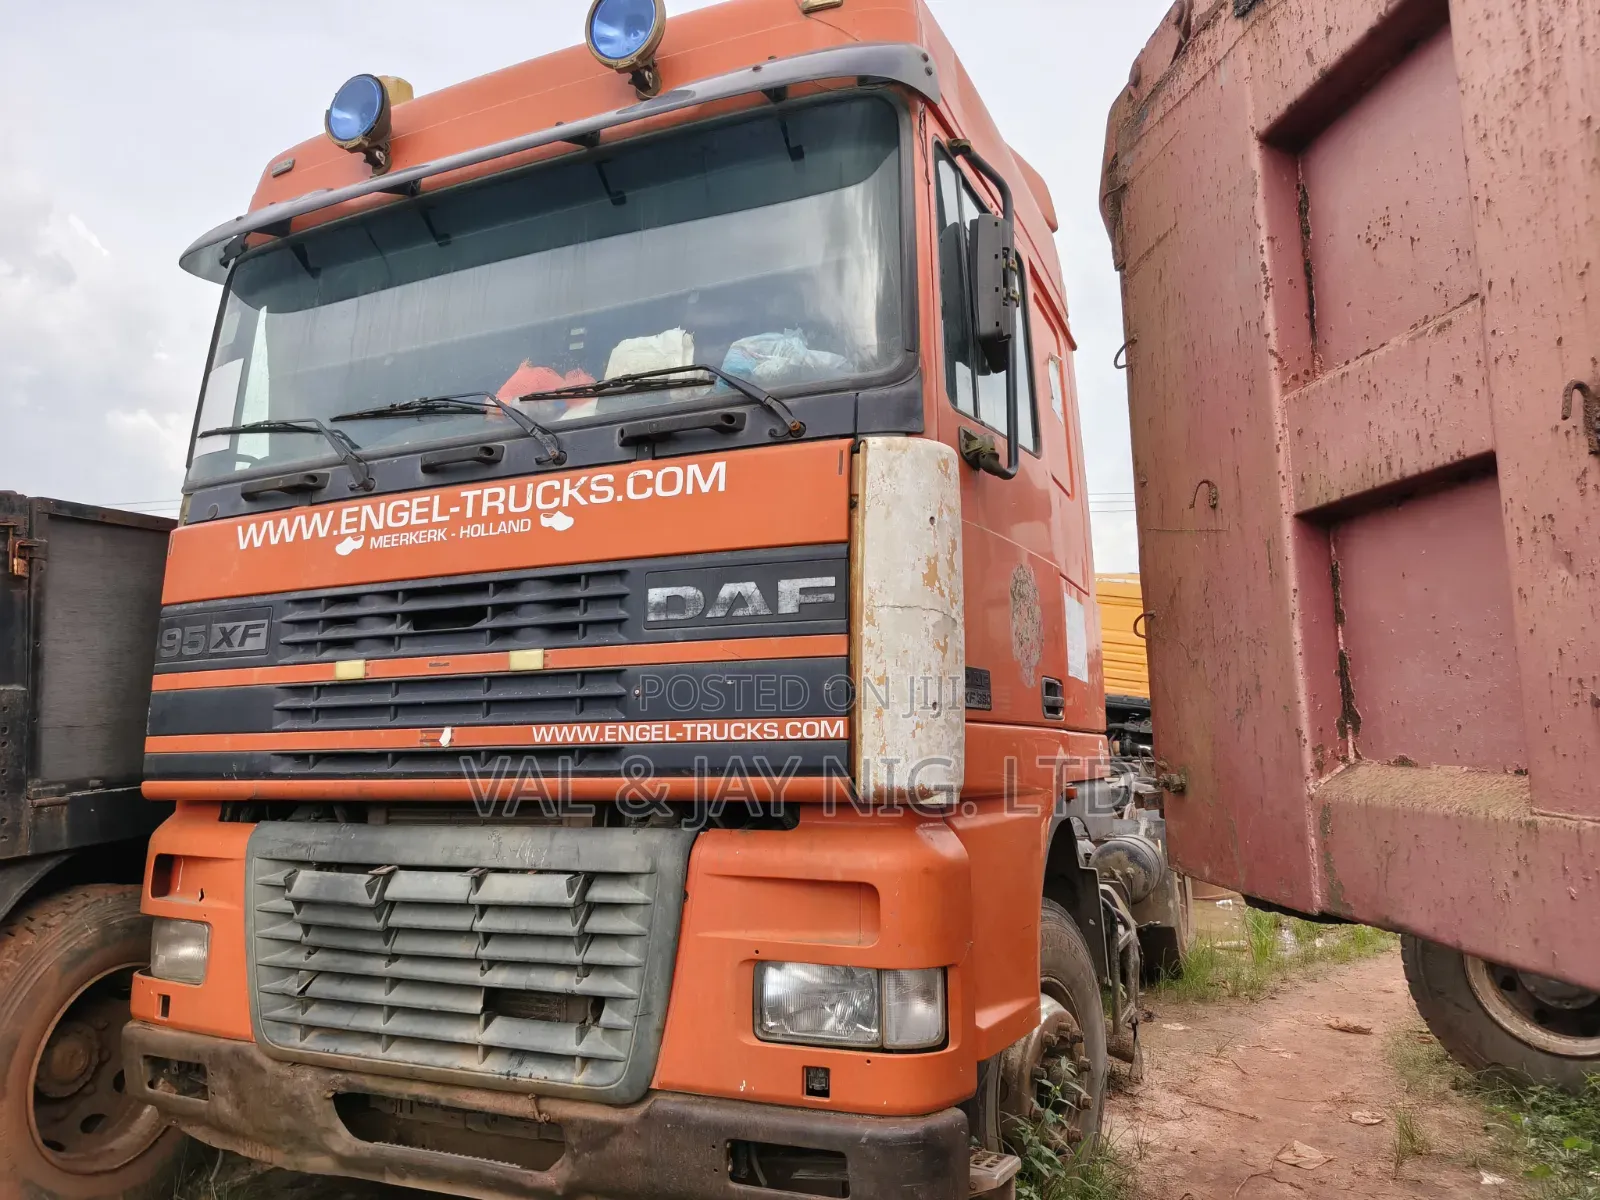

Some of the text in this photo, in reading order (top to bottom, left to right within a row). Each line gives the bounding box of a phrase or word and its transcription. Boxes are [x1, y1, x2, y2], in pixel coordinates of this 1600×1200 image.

[237, 461, 727, 550] WWW.ENGEL-TRUCKS.COM
[369, 527, 448, 550] MEERKERK
[459, 518, 532, 538] HOLLAND
[647, 576, 836, 622] DAF
[160, 623, 266, 658] 95 XF
[532, 719, 845, 743] WWW.ENGEL-TRUCKS.COM
